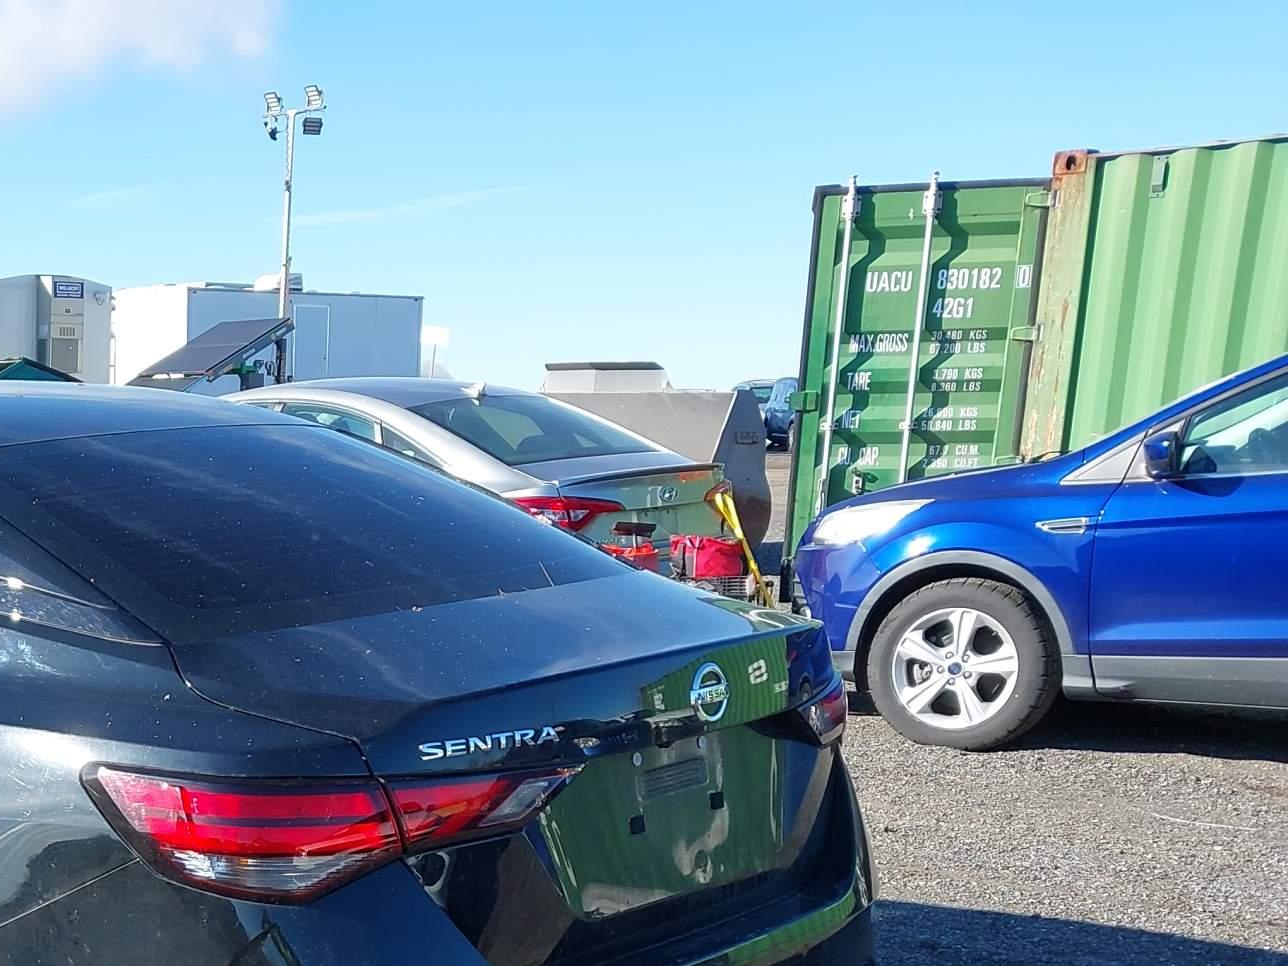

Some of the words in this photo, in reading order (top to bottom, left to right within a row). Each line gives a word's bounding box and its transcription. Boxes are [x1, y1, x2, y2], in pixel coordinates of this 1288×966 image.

[866, 271, 912, 292] UACU
[937, 267, 1002, 289] 830182
[932, 298, 974, 318] 42G1
[969, 329, 988, 340] KGS
[967, 342, 986, 354] LBS
[847, 372, 872, 391] TARE
[964, 367, 984, 380] KGS
[963, 381, 982, 392] LBS
[841, 410, 862, 429] NET
[960, 407, 978, 418] KGS
[958, 419, 977, 431] LBS
[419, 726, 561, 761] SENTRA
